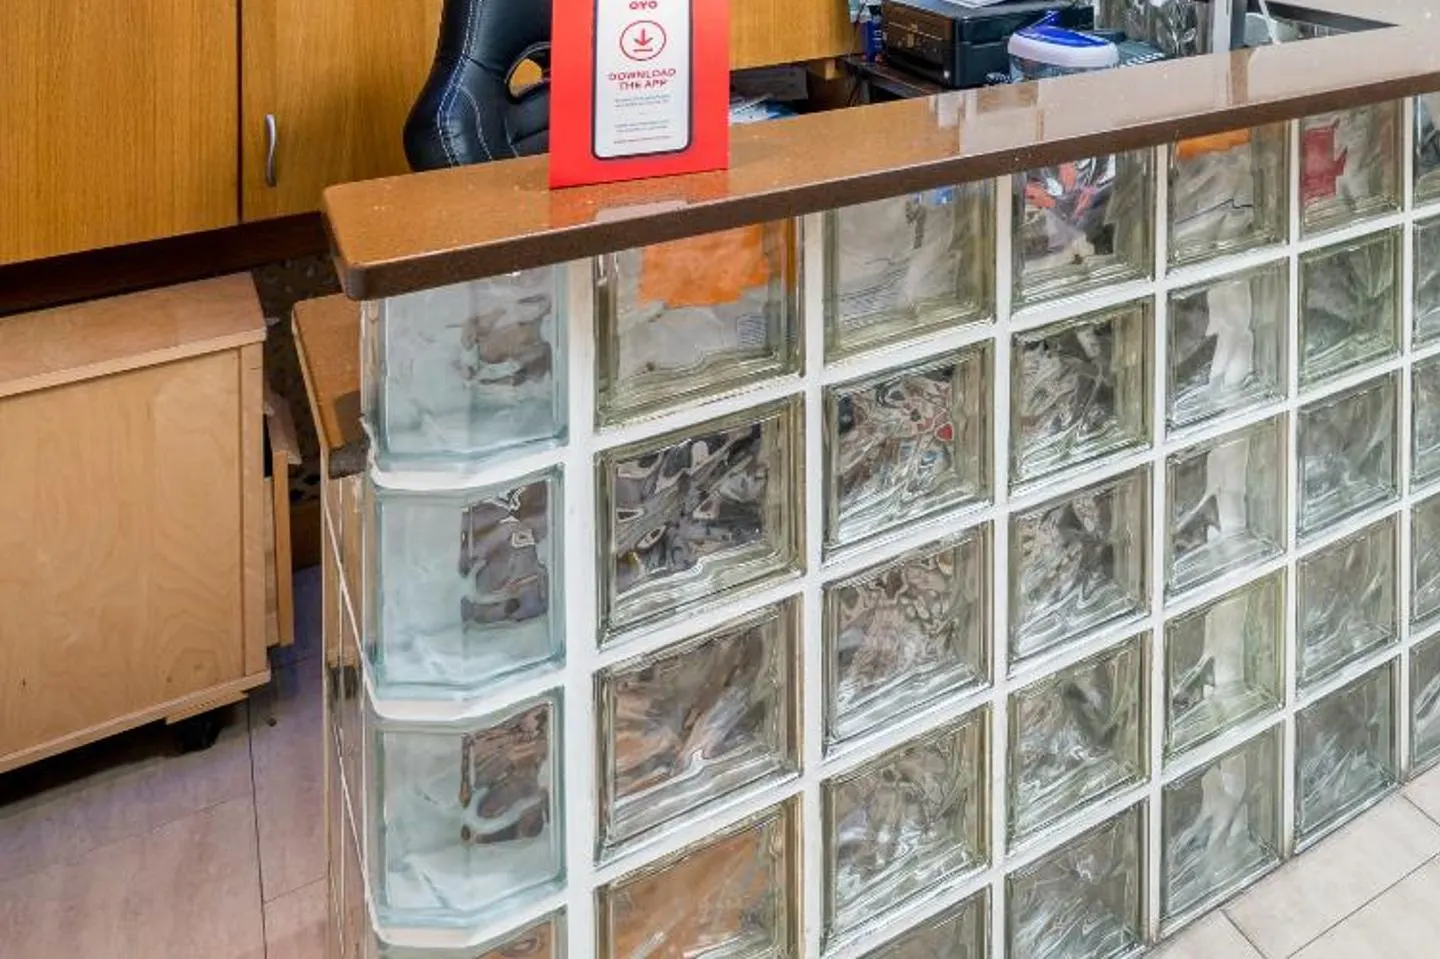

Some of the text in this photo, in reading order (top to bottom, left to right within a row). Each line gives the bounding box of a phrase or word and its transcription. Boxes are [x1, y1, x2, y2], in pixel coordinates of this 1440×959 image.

[629, 0, 658, 10] OYO
[608, 67, 677, 81] DOWNLOAD
[620, 78, 668, 91] THE APP
